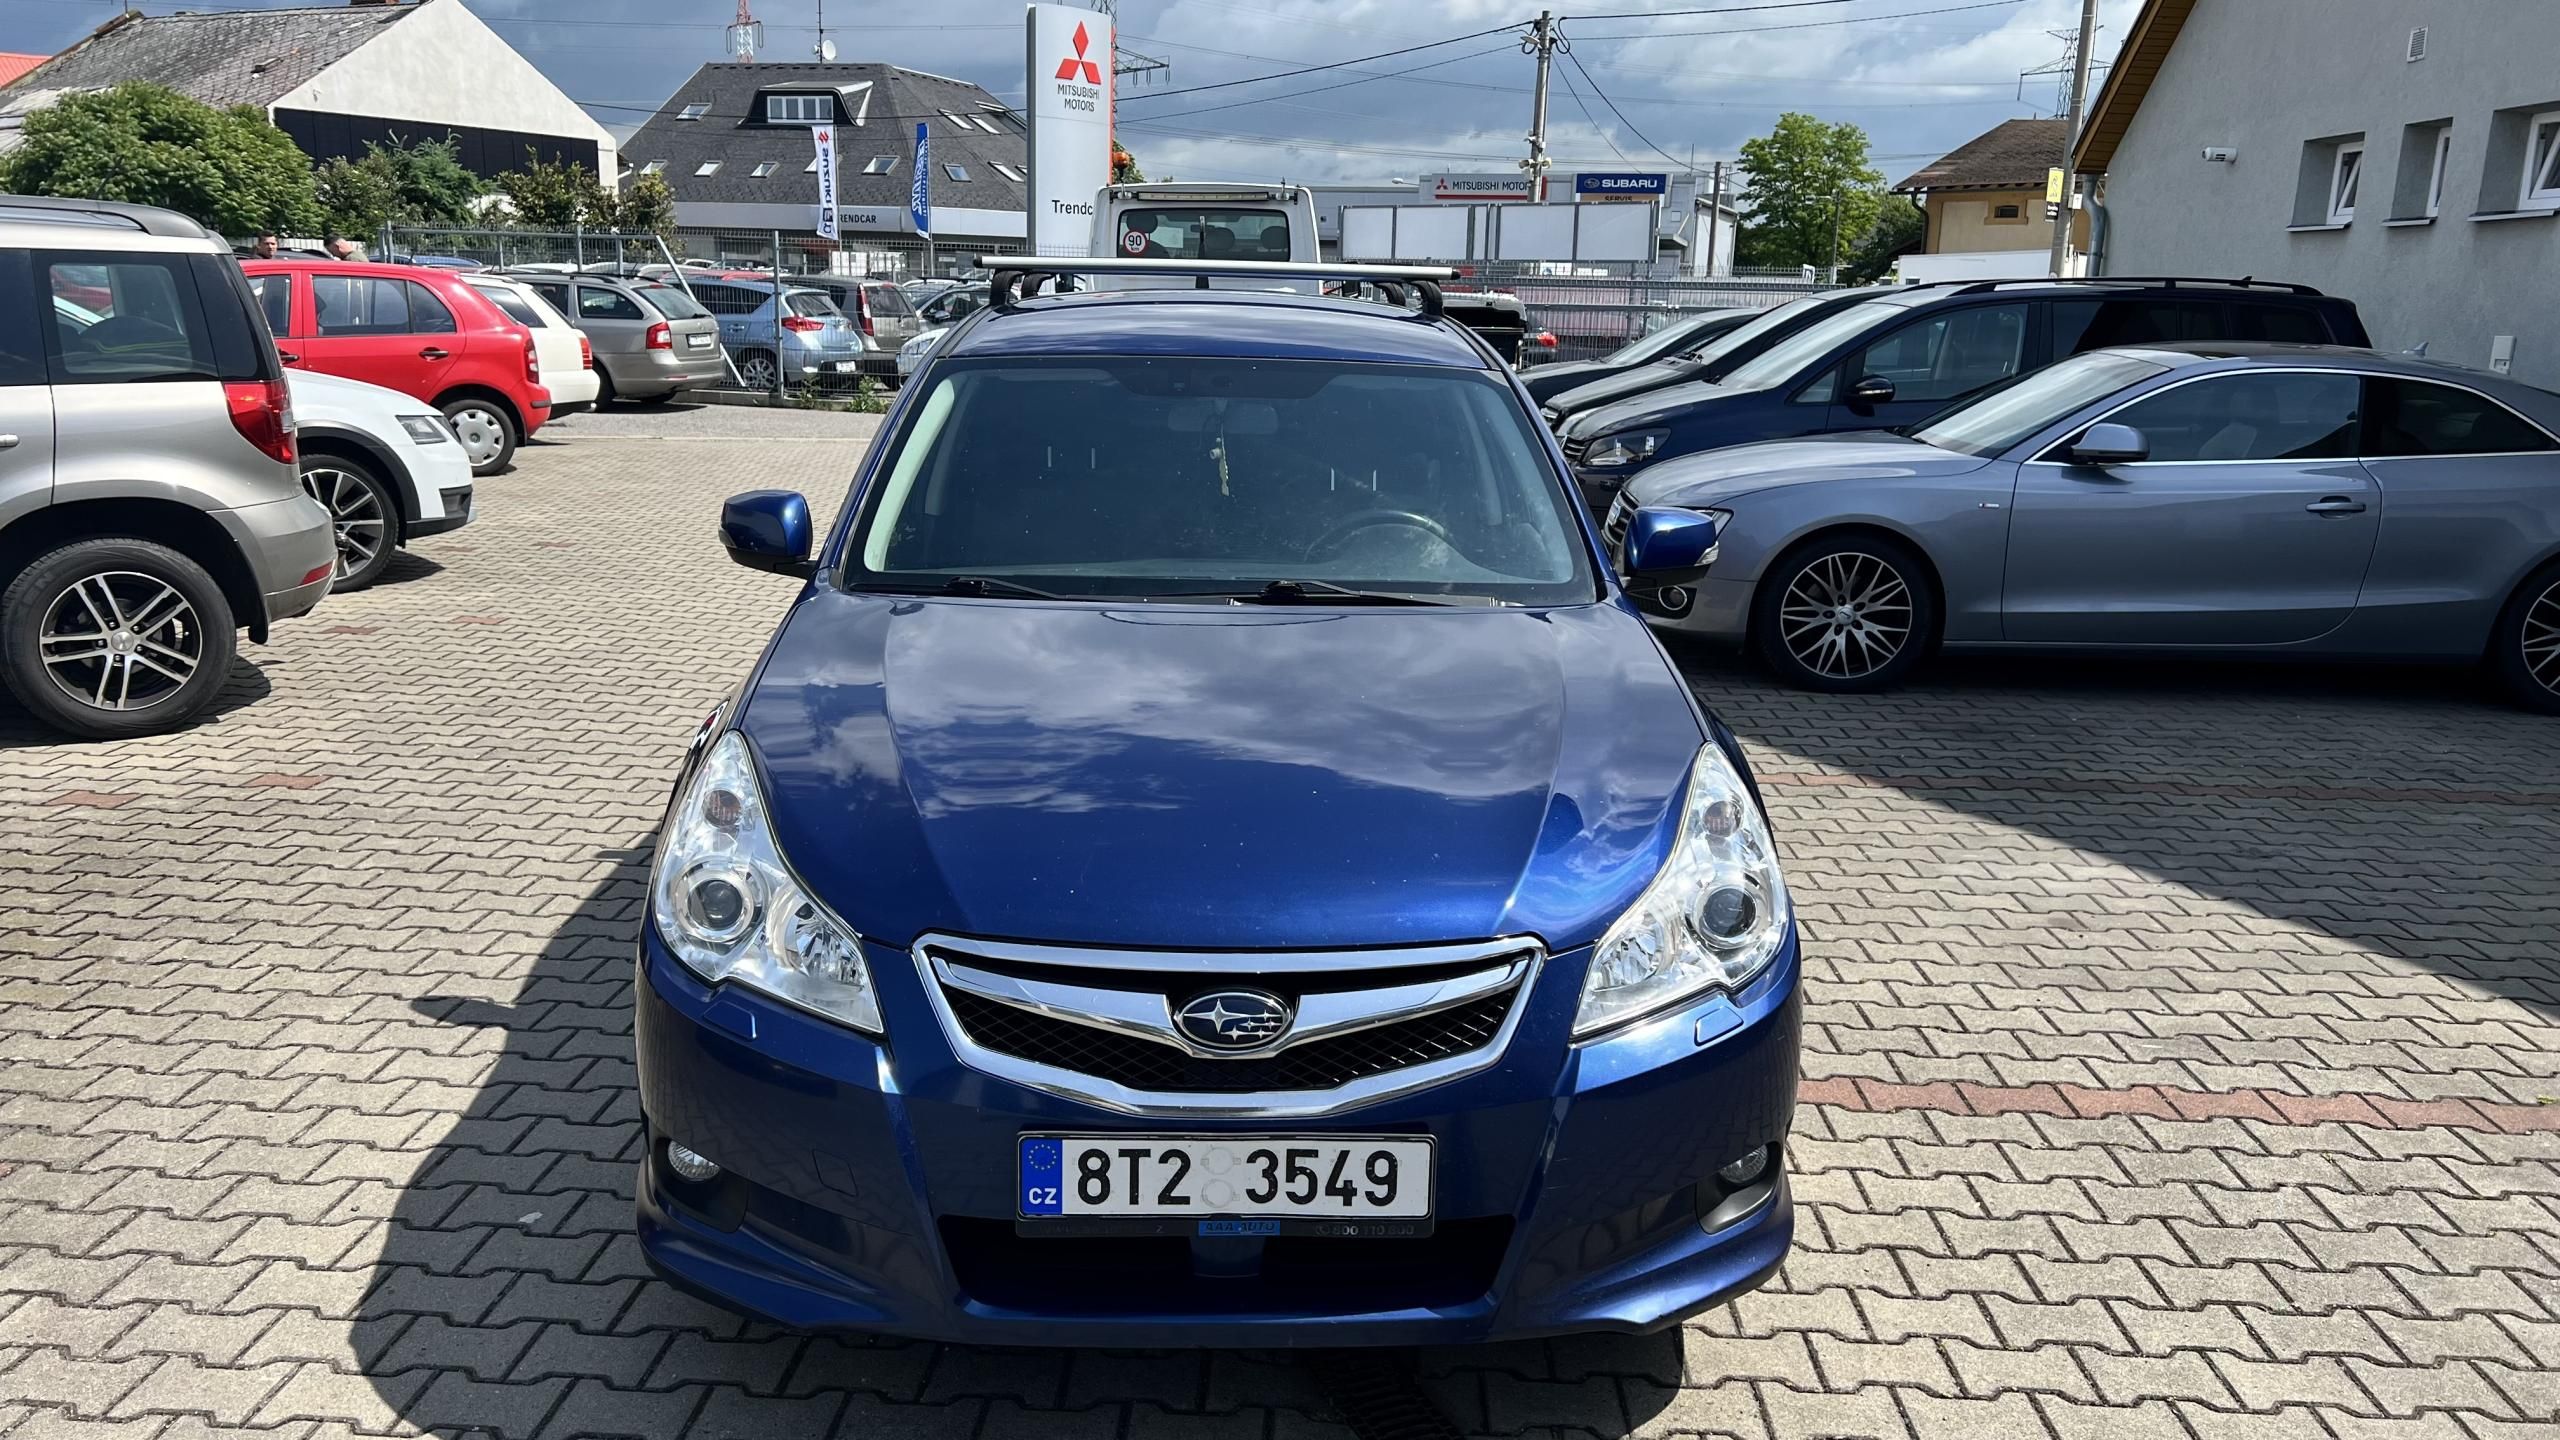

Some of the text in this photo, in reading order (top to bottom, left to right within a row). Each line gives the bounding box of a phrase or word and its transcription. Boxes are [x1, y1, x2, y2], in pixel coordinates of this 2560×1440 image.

[1057, 83, 1100, 100] MITSUBISHI
[1064, 98, 1095, 112] MOTORS
[1452, 180, 1499, 191] MITSUBISHI
[1601, 179, 1658, 188] SUBARU
[1051, 199, 1093, 215] Trendc
[1128, 234, 1142, 247] 90
[1076, 1148, 1399, 1207] 8T2 3549
[1028, 1187, 1058, 1206] CZ
